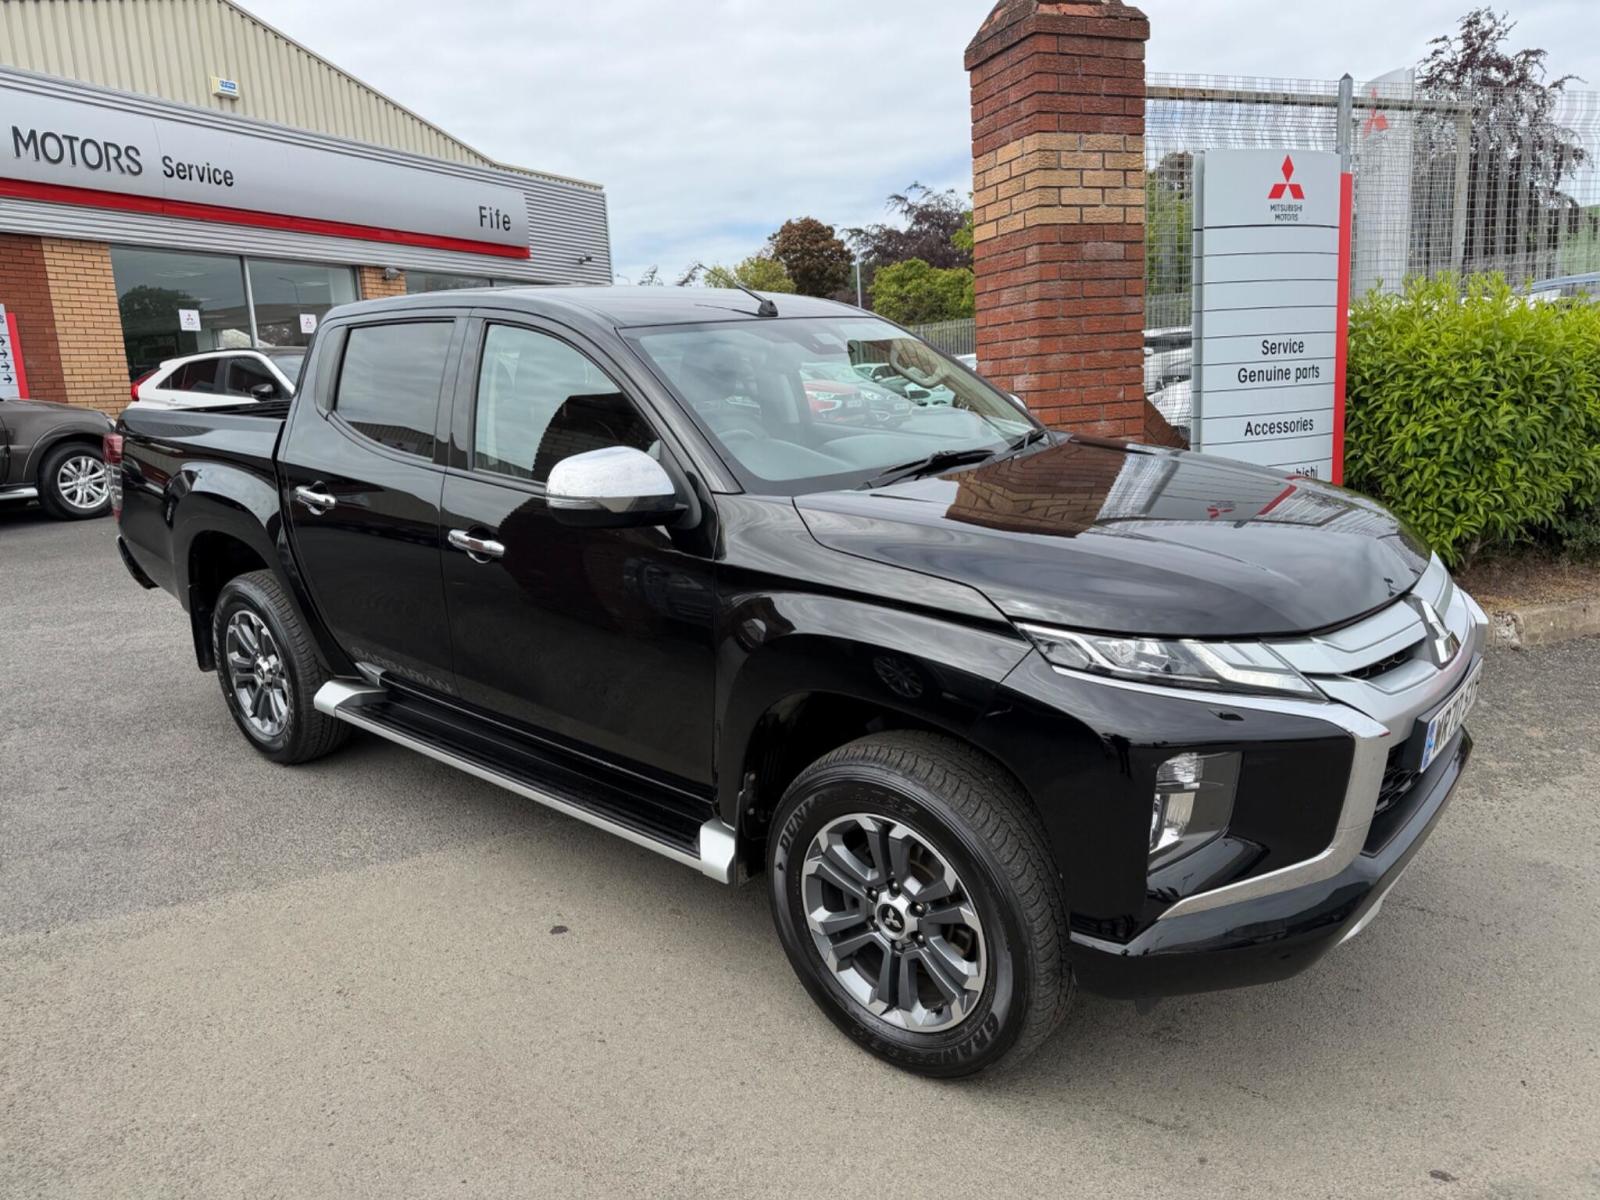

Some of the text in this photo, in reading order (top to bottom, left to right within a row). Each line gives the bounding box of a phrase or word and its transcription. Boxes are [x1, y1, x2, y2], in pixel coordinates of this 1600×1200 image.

[11, 125, 234, 187] MOTORS Service
[1270, 203, 1303, 212] MITSUBISHI
[478, 205, 511, 231] Fife
[1261, 338, 1304, 355] Service
[1238, 364, 1320, 383] Genuine parts
[1244, 417, 1314, 436] Accessories
